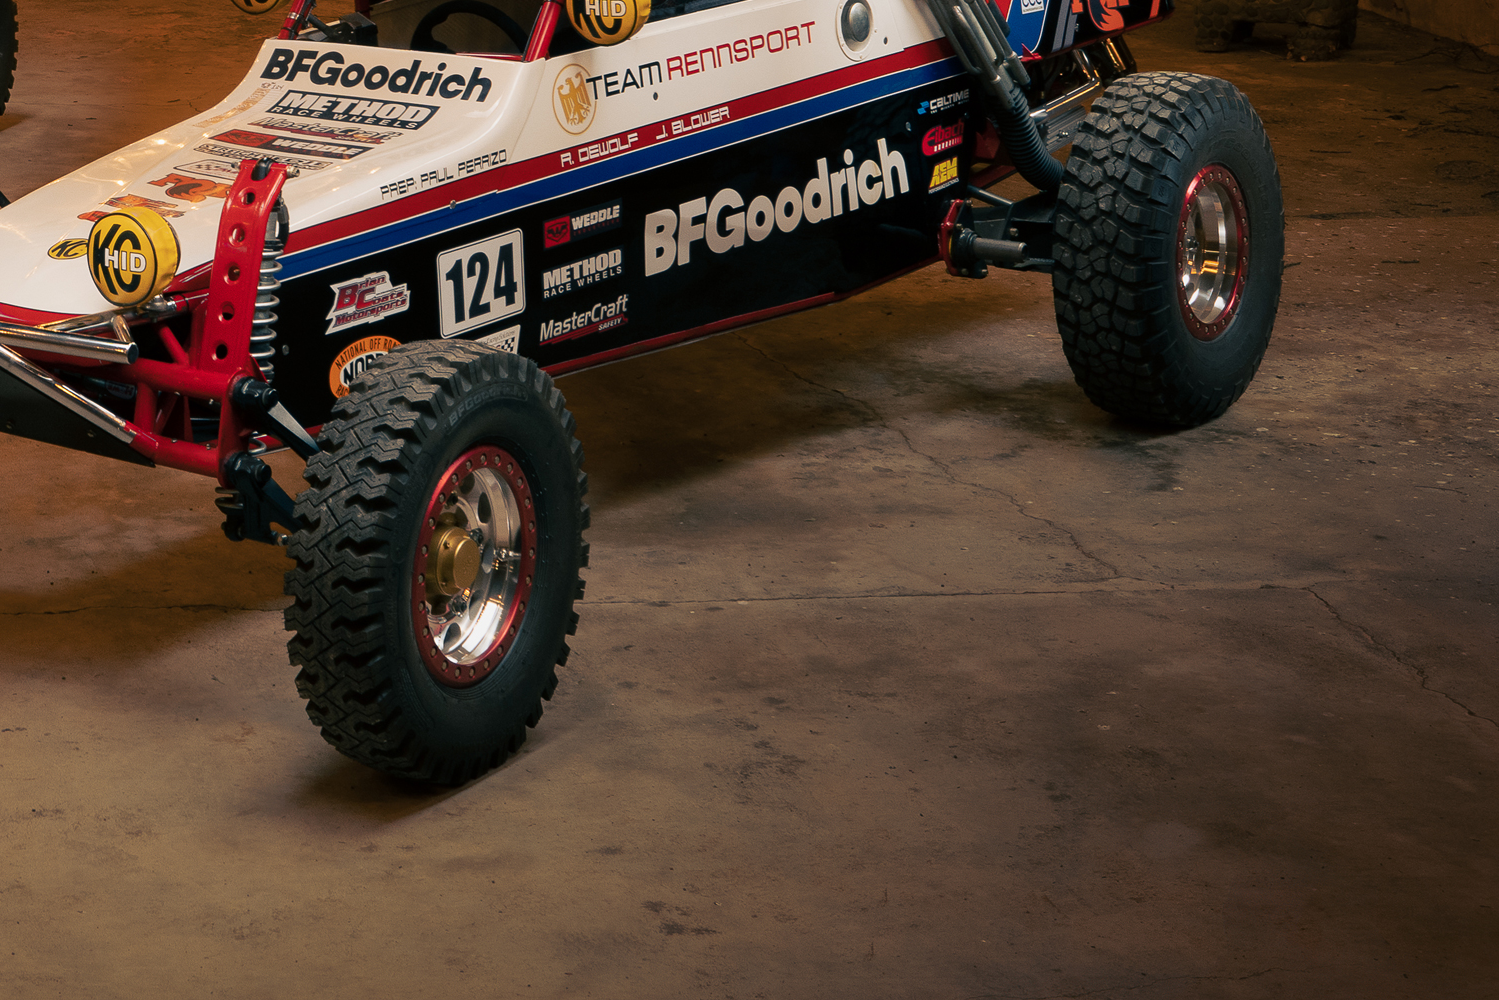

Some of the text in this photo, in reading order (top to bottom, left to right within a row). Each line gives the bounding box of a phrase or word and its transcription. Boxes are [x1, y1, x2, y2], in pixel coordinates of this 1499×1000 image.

[260, 48, 493, 103] BFGoodrich
[585, 20, 816, 101] TEAM RENNSPORT
[270, 106, 419, 130] RACE WHEELS
[277, 92, 433, 122] METHOD
[254, 116, 404, 141] MasterCraft
[577, 132, 639, 163] DEWOLF
[655, 124, 669, 140] J.
[671, 105, 731, 135] BLOWER
[922, 117, 965, 156] Eibach
[271, 138, 364, 156] WEDDLE
[420, 167, 454, 188] PAUL
[457, 148, 507, 177] PERRIZO
[929, 156, 958, 188] AEM
[571, 204, 620, 231] WEDDLE
[644, 137, 910, 278] BFGoodrich
[51, 240, 88, 258] KC
[92, 223, 142, 296] KC
[104, 247, 147, 273] HID
[445, 241, 518, 325] 124
[543, 248, 622, 290] METHOD
[543, 265, 622, 299] RACE WHEELS
[332, 298, 409, 328] Motorsports
[540, 294, 628, 342] MasterCraft
[598, 316, 622, 331] SAFETY
[335, 338, 400, 370] NATIONAL OFF ROA
